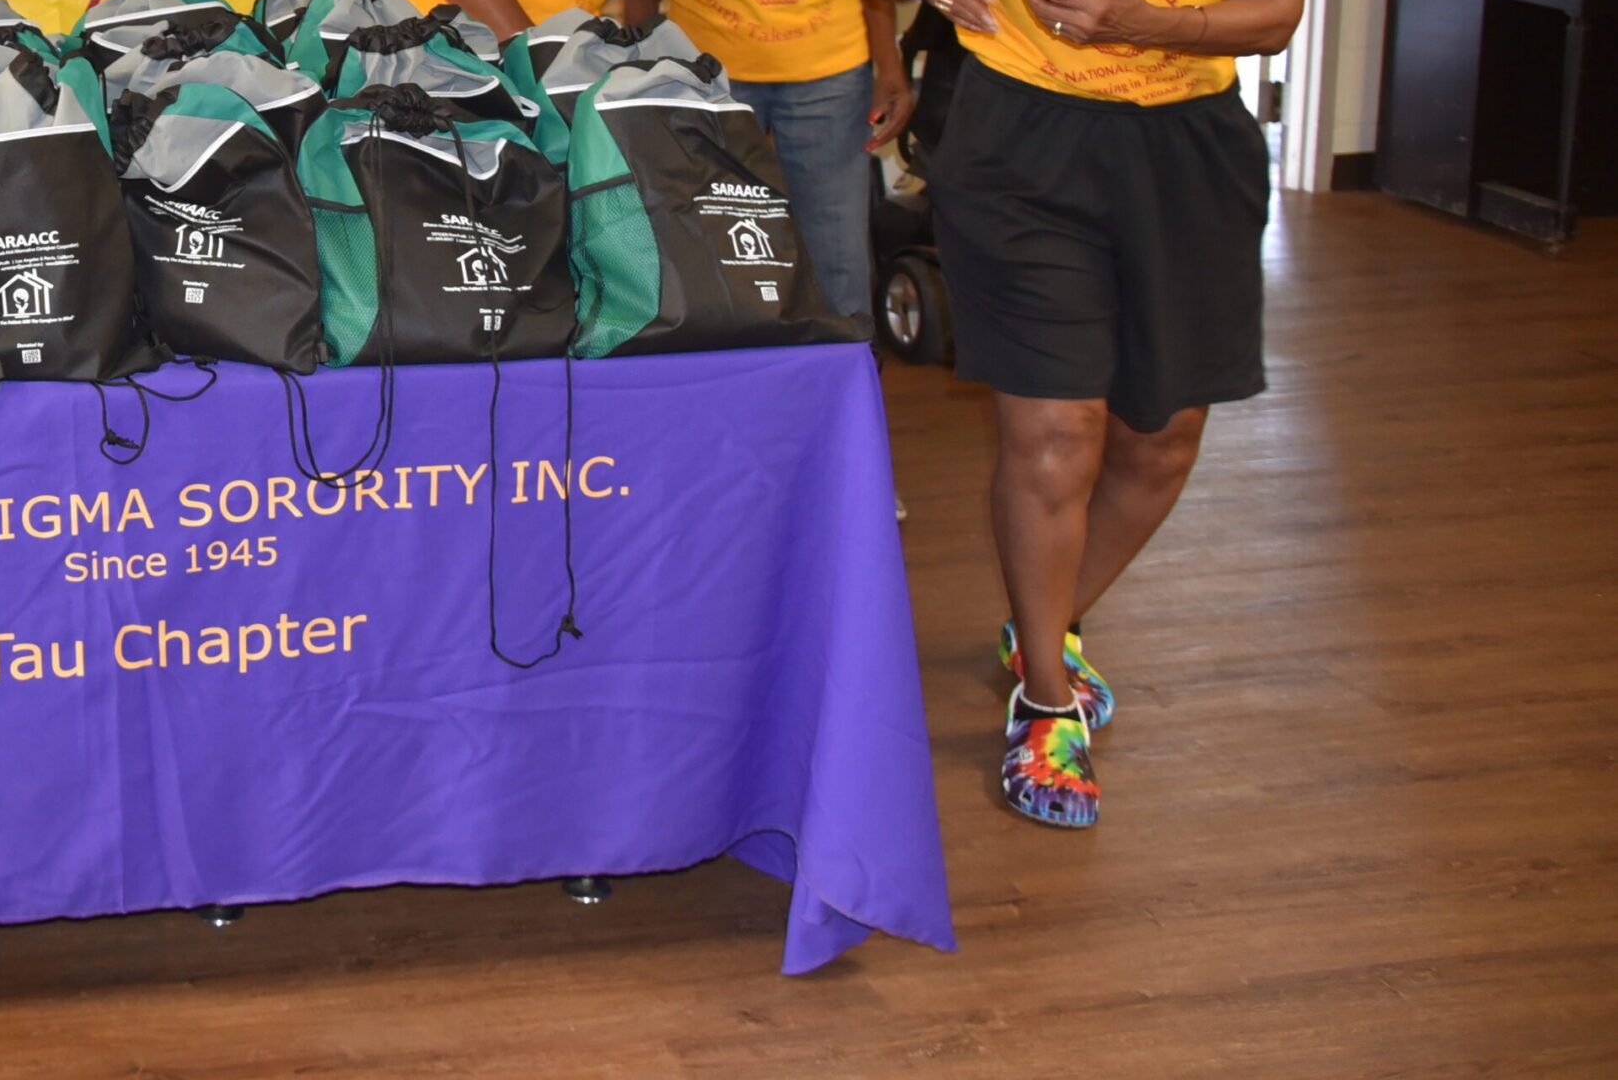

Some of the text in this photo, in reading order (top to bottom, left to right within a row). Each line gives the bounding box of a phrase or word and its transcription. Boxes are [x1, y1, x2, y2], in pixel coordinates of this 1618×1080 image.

[711, 182, 771, 199] SARAACC
[178, 462, 489, 527] SORORITY
[511, 455, 630, 503] INC.
[64, 536, 278, 582] Since 1945
[114, 612, 367, 673] Chapter
